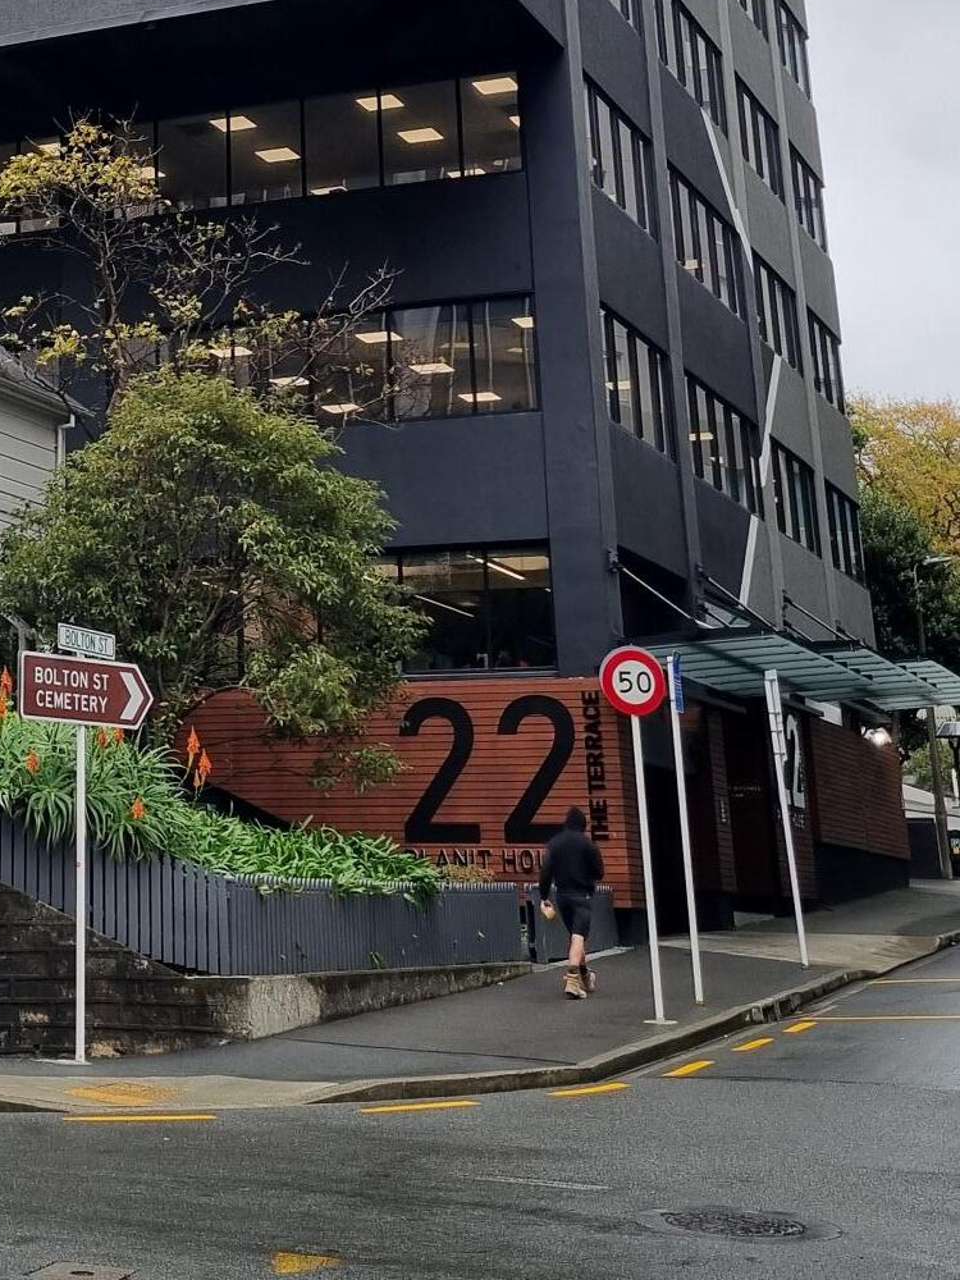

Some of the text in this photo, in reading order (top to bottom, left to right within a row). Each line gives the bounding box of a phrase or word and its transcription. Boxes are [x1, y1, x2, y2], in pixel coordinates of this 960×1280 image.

[64, 628, 109, 652] BOLTON ST
[34, 666, 110, 691] BOLTON ST
[617, 671, 652, 694] 50
[35, 690, 108, 713] CEMETERY
[580, 689, 608, 796] TERRACE
[399, 694, 576, 845] 22
